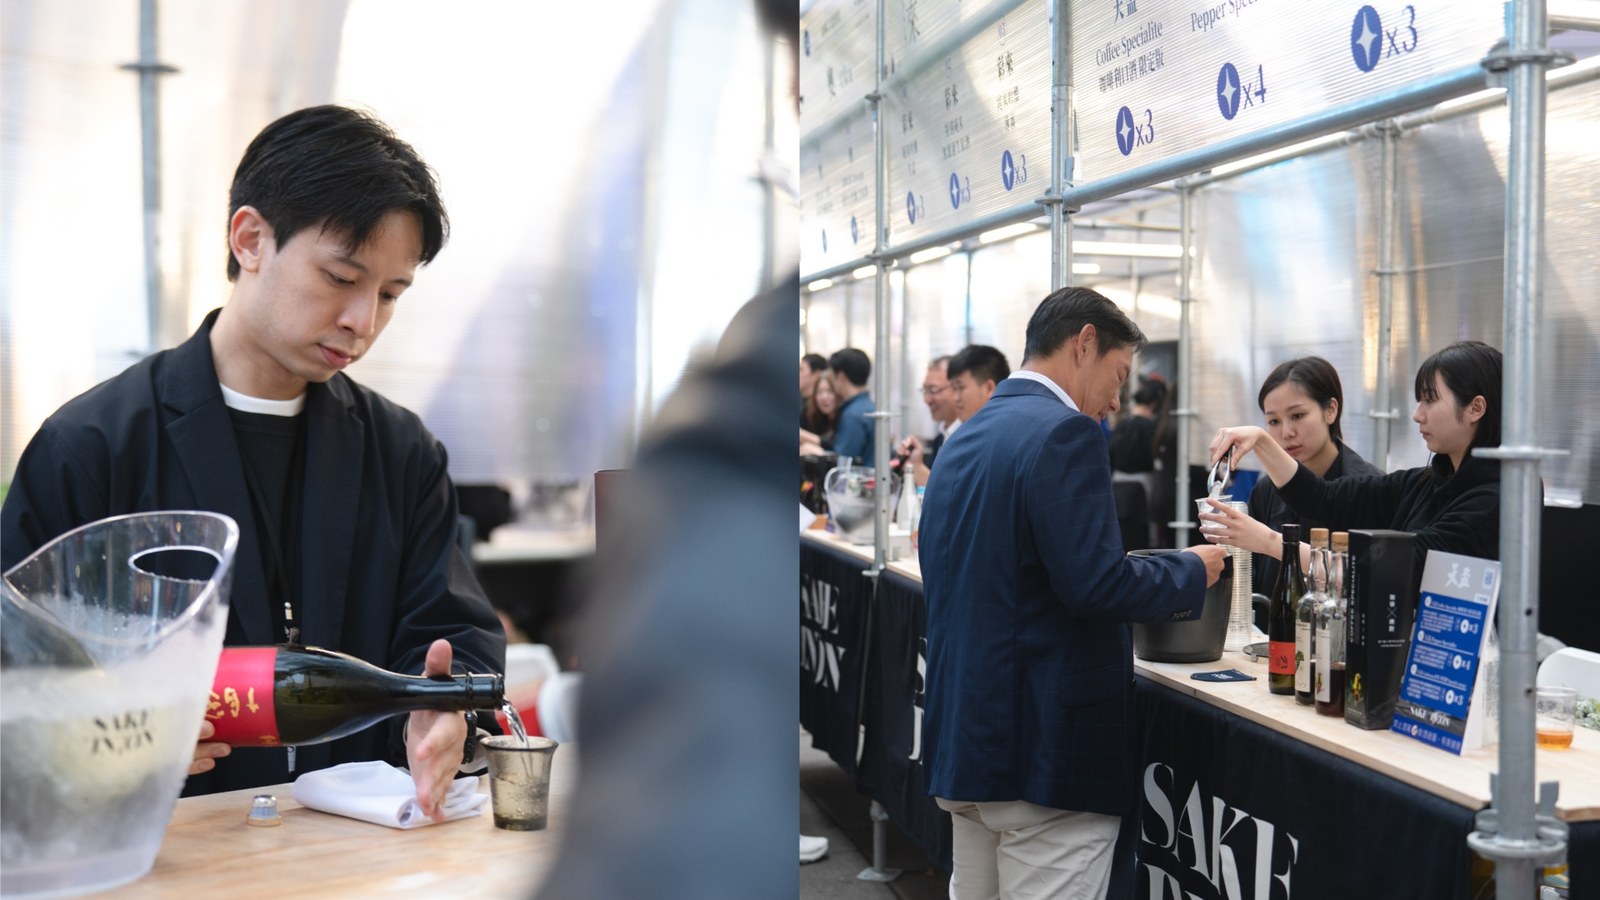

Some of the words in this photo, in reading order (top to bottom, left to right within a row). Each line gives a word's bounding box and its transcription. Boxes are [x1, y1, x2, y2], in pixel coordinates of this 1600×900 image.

[1190, 2, 1226, 33] Pepper
[1385, 4, 1418, 58] x3
[1095, 41, 1120, 67] Coffee
[1121, 21, 1163, 57] Specialite
[1242, 64, 1267, 110] x4
[1135, 108, 1154, 148] x3
[1014, 153, 1027, 185] x3
[1141, 762, 1299, 900] SAKE
